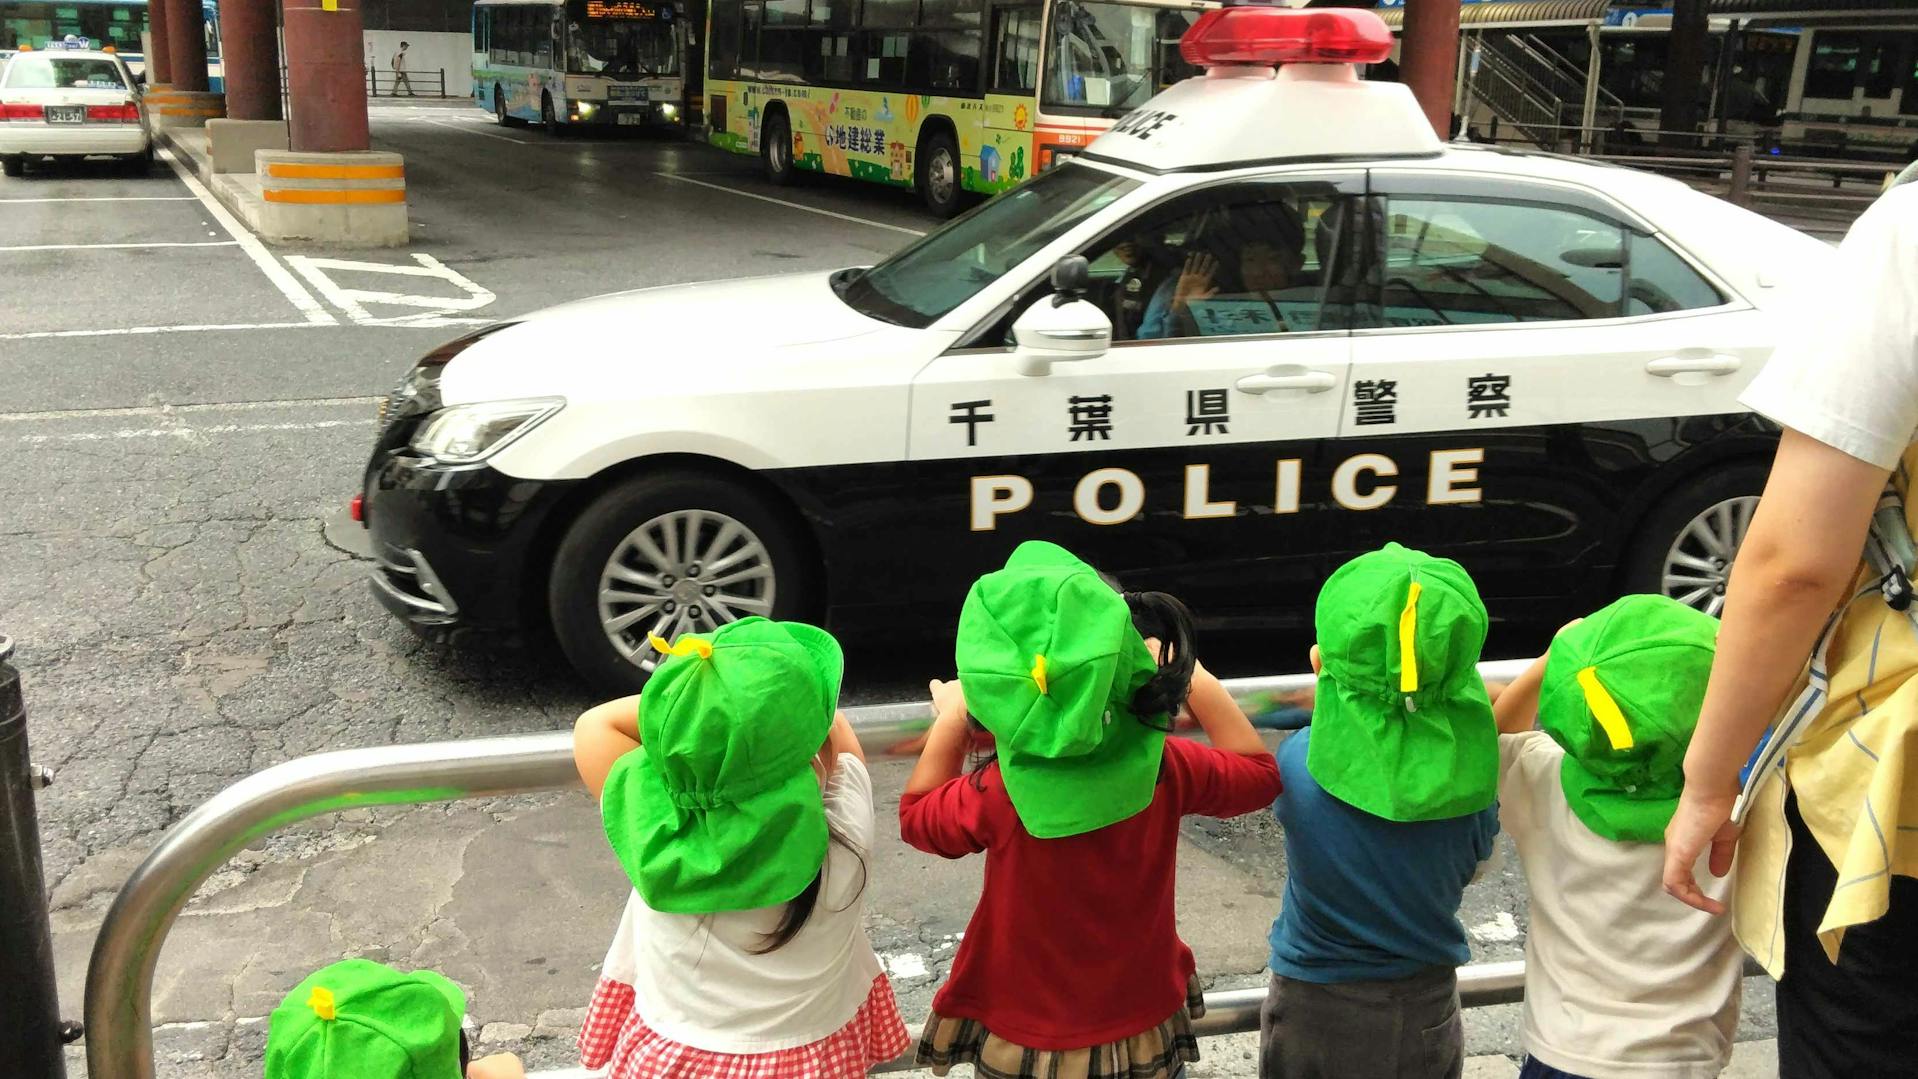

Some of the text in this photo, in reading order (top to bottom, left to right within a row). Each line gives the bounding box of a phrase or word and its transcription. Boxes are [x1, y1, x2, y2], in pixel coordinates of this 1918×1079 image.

[836, 124, 885, 155] 地建総業
[949, 374, 1511, 447] 千葉県警察
[970, 447, 1485, 531] POLICE
